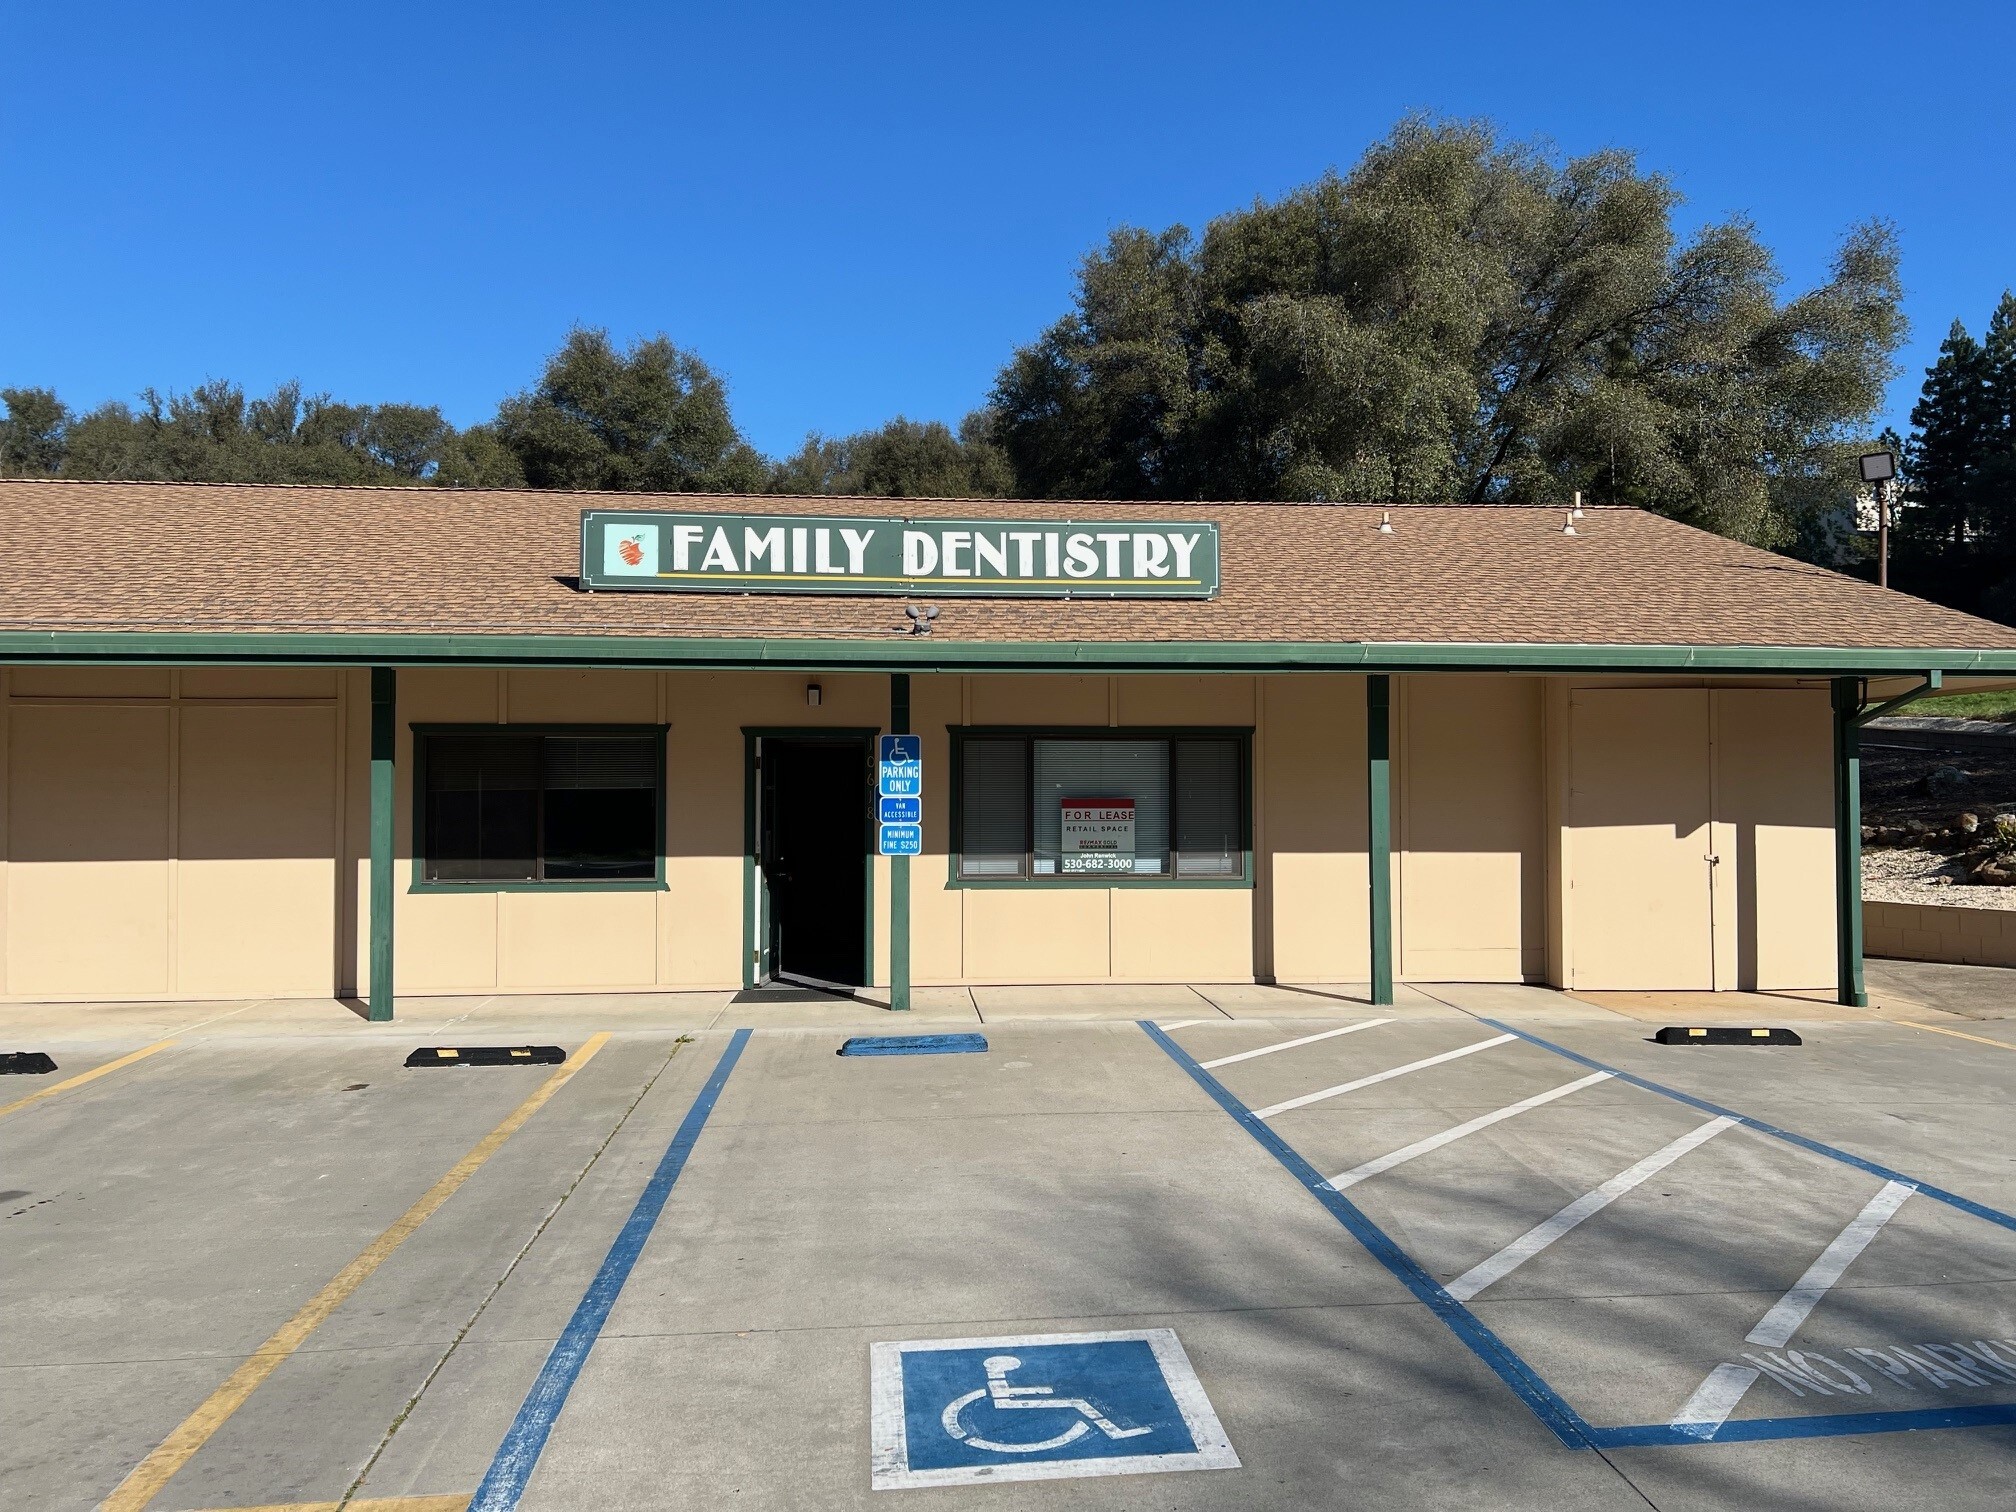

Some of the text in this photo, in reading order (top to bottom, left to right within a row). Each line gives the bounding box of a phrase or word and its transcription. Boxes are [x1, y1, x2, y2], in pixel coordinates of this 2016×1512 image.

[672, 524, 1201, 578] FAMILY DENTISTRY
[882, 766, 919, 779] PARKING
[889, 780, 911, 792] ONLY
[1065, 811, 1135, 820] FOR LEASE
[887, 830, 914, 839] MINIMUM
[883, 841, 918, 849] FINE $250
[1064, 859, 1132, 869] 530-682-3000
[1740, 1339, 2016, 1397] NO PARK
